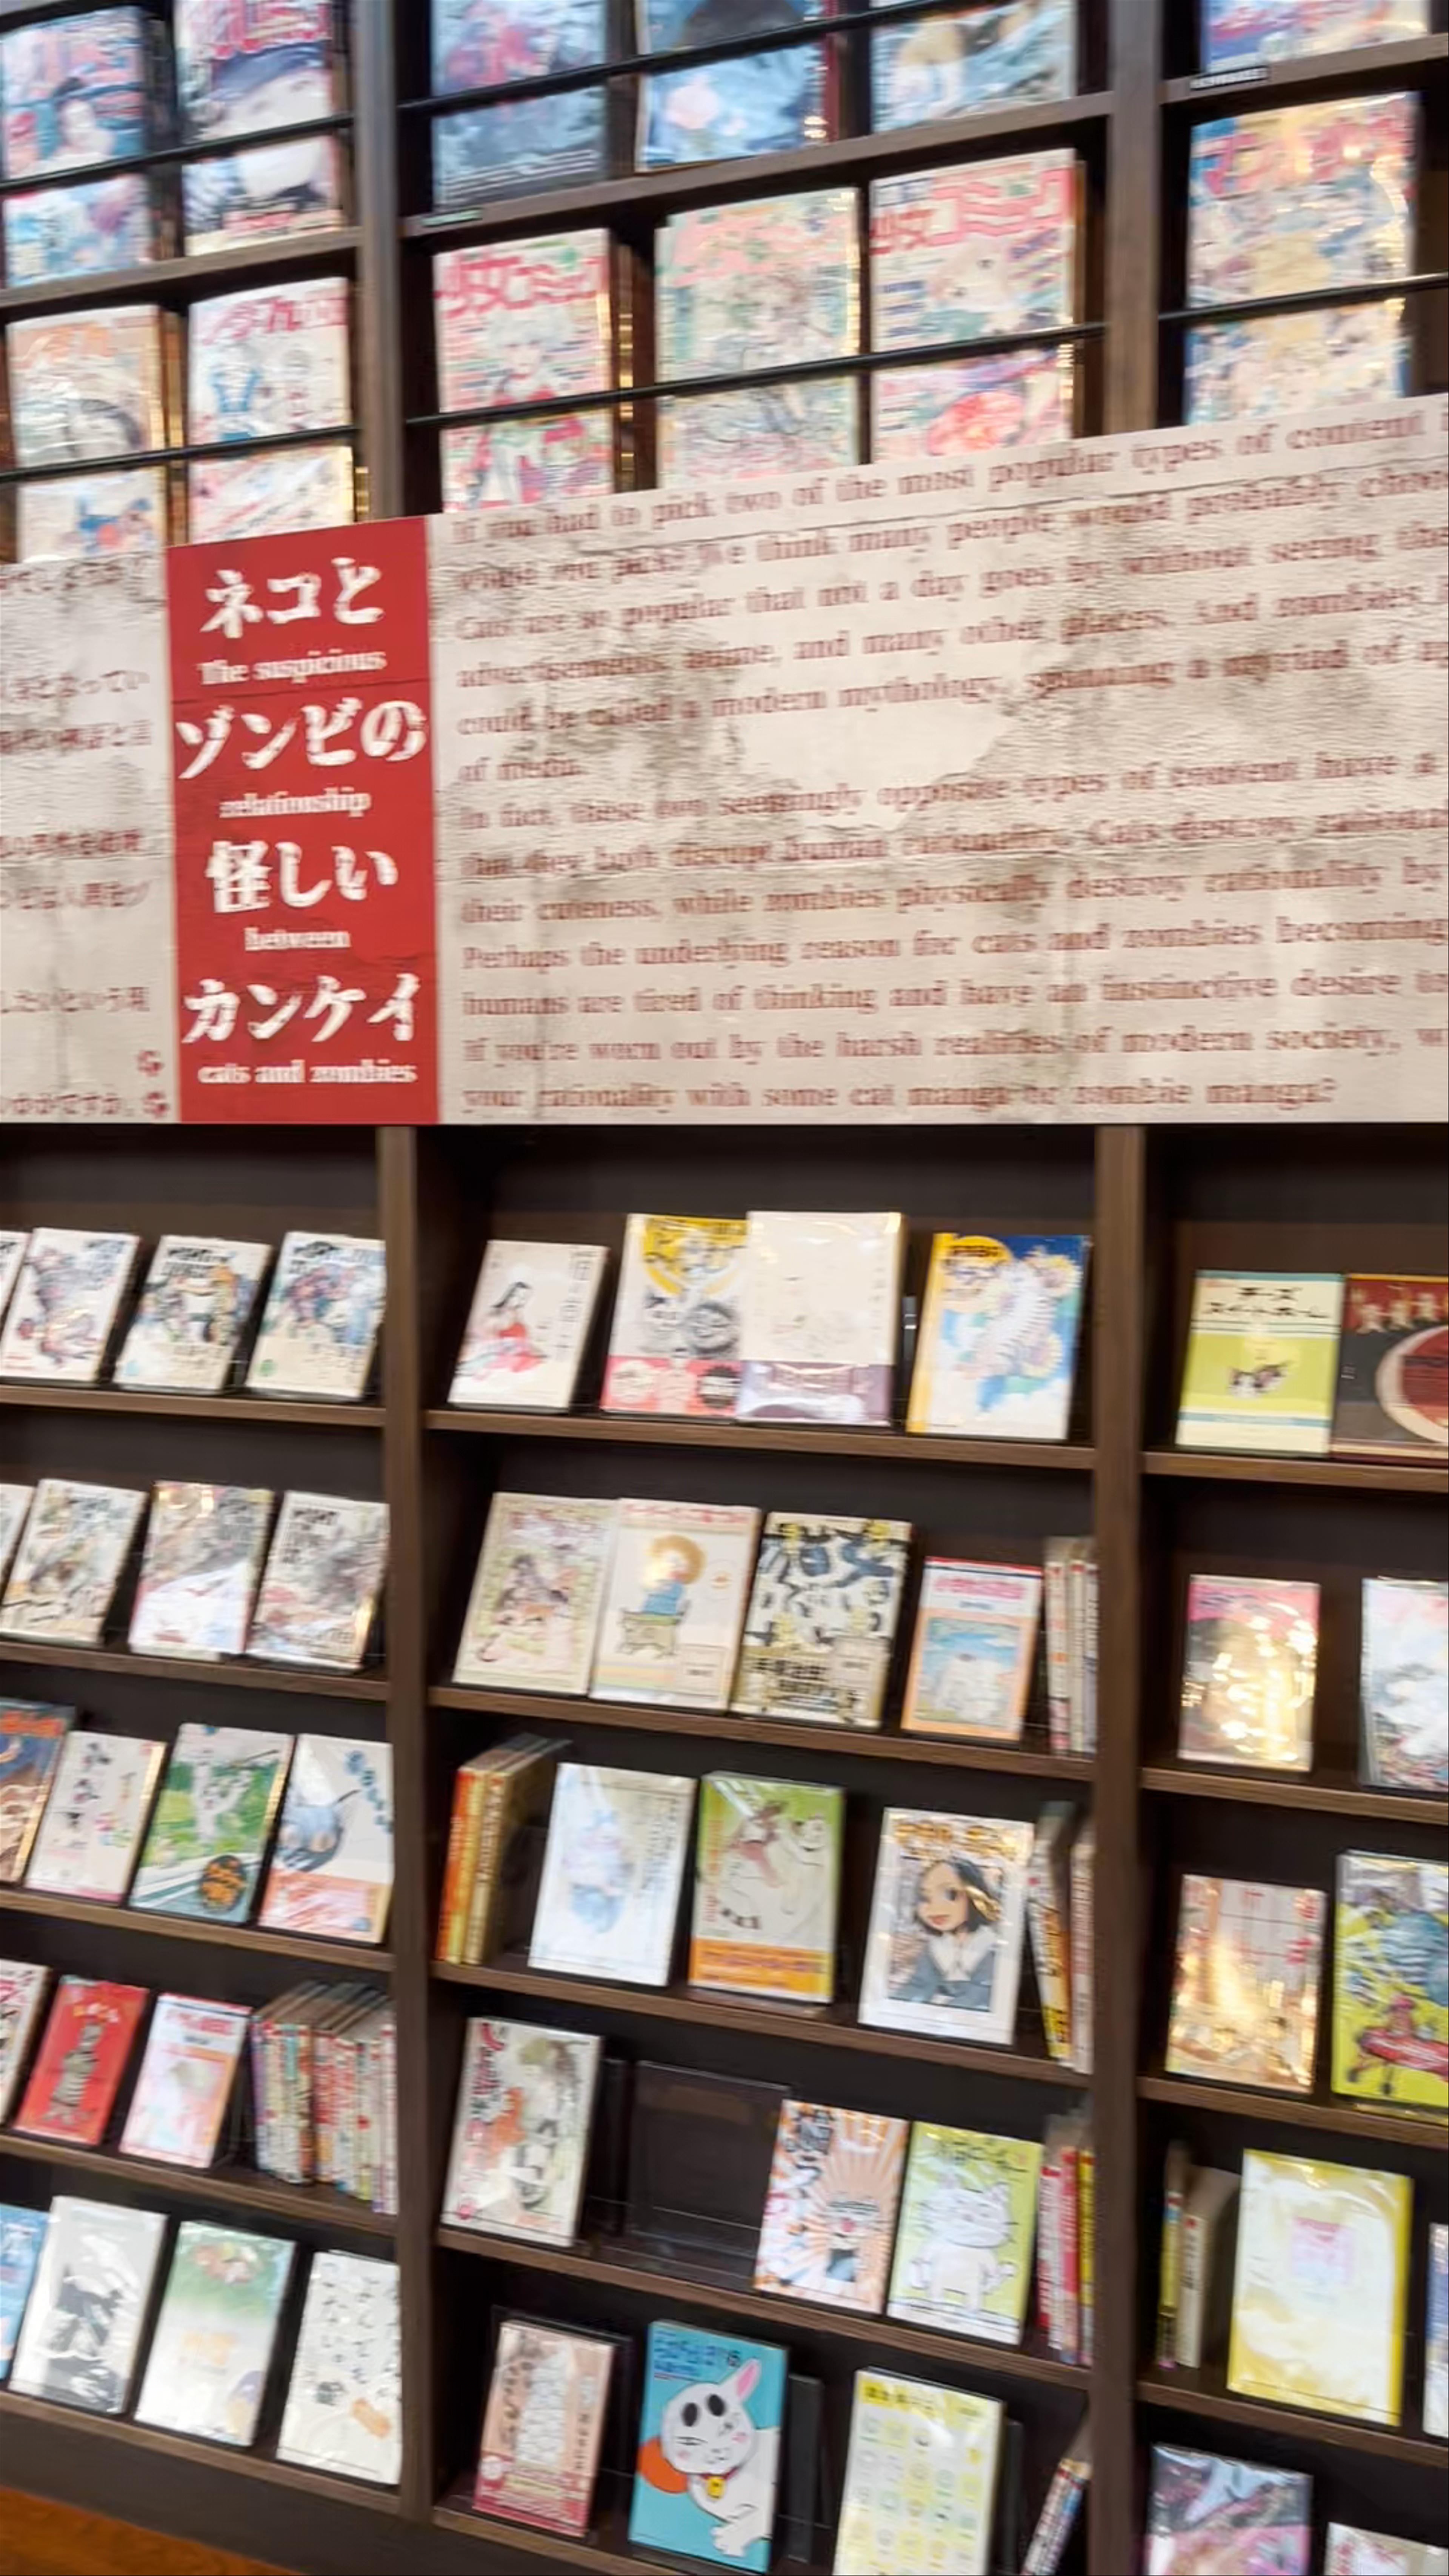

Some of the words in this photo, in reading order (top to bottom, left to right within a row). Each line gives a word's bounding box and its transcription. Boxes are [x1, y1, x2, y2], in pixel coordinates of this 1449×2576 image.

[199, 557, 384, 638] ネコと
[197, 659, 249, 685] The
[253, 648, 387, 683] suspicious
[175, 697, 427, 779] ゾンビの
[219, 786, 371, 818] relationship
[205, 840, 398, 913] 怪しい
[245, 927, 351, 951] between
[181, 973, 420, 1043] カンケイ
[198, 1062, 252, 1083] cats
[254, 1059, 305, 1083] and
[309, 1059, 418, 1083] zombies
